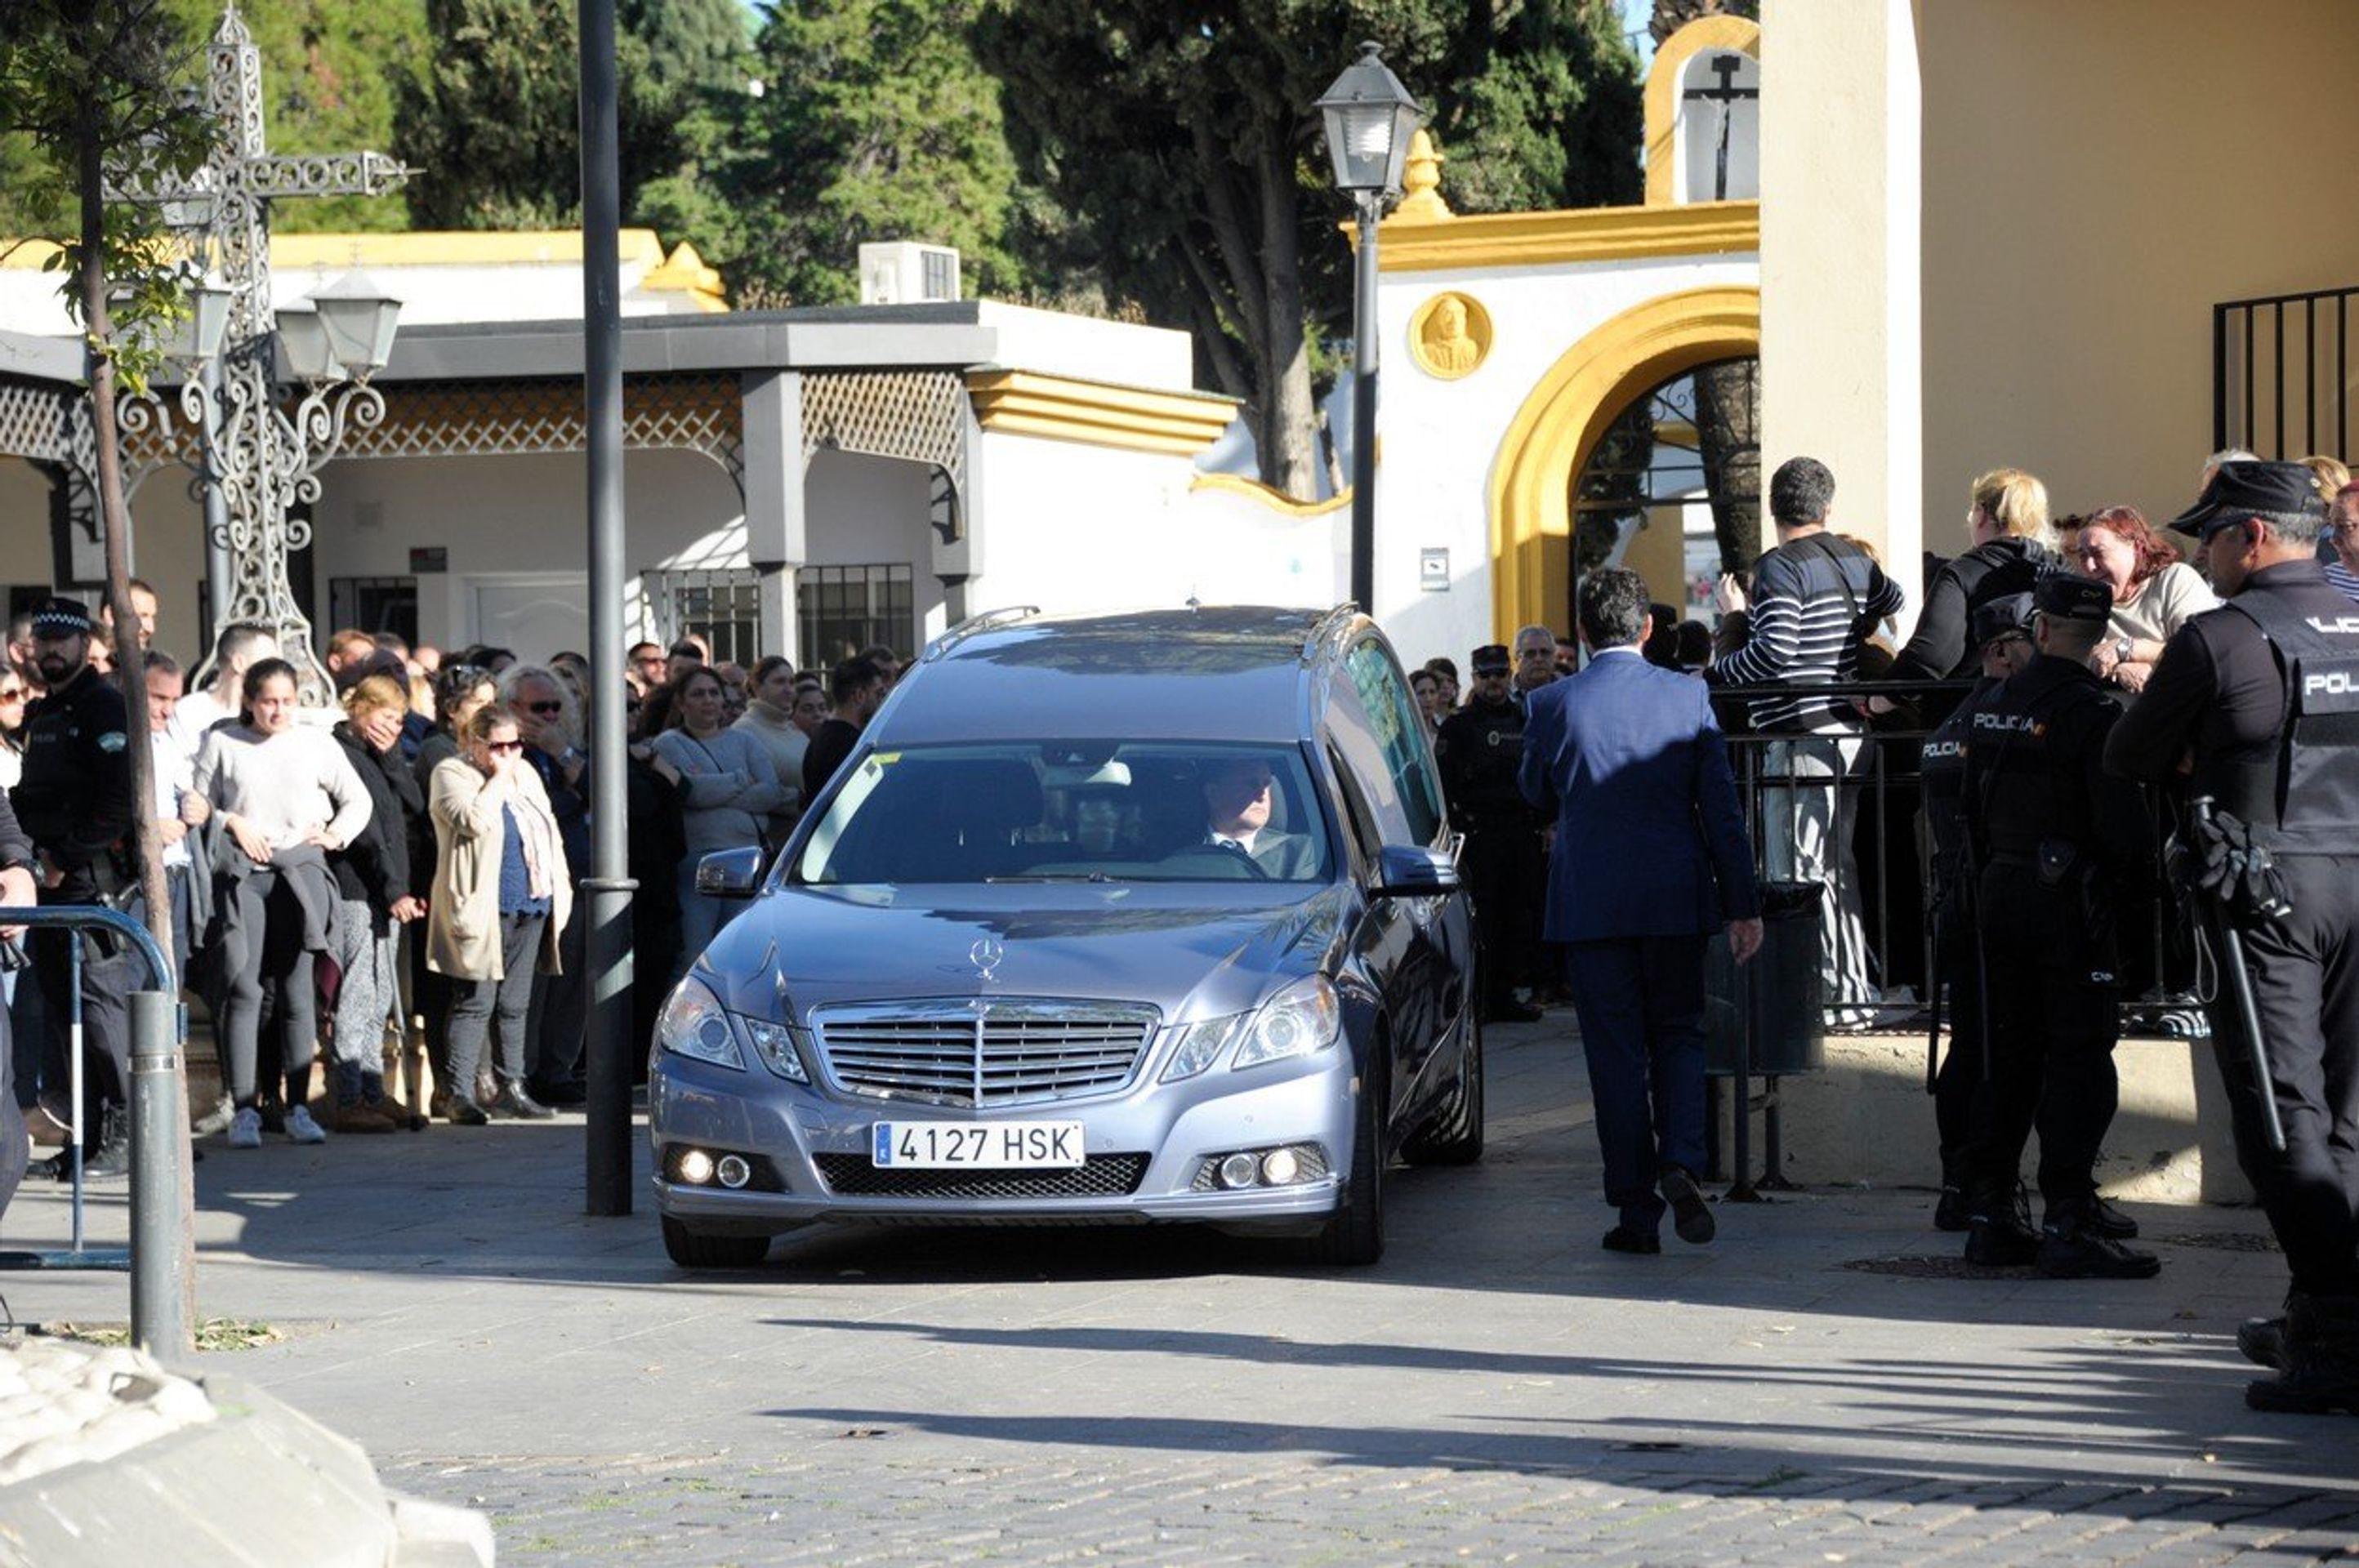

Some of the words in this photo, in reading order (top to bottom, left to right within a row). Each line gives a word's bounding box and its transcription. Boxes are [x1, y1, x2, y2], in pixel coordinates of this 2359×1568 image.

[2305, 672, 2359, 696] POL
[1973, 713, 2035, 732] POLICIA
[899, 1129, 988, 1161] 4127
[1004, 1128, 1071, 1160] HSK
